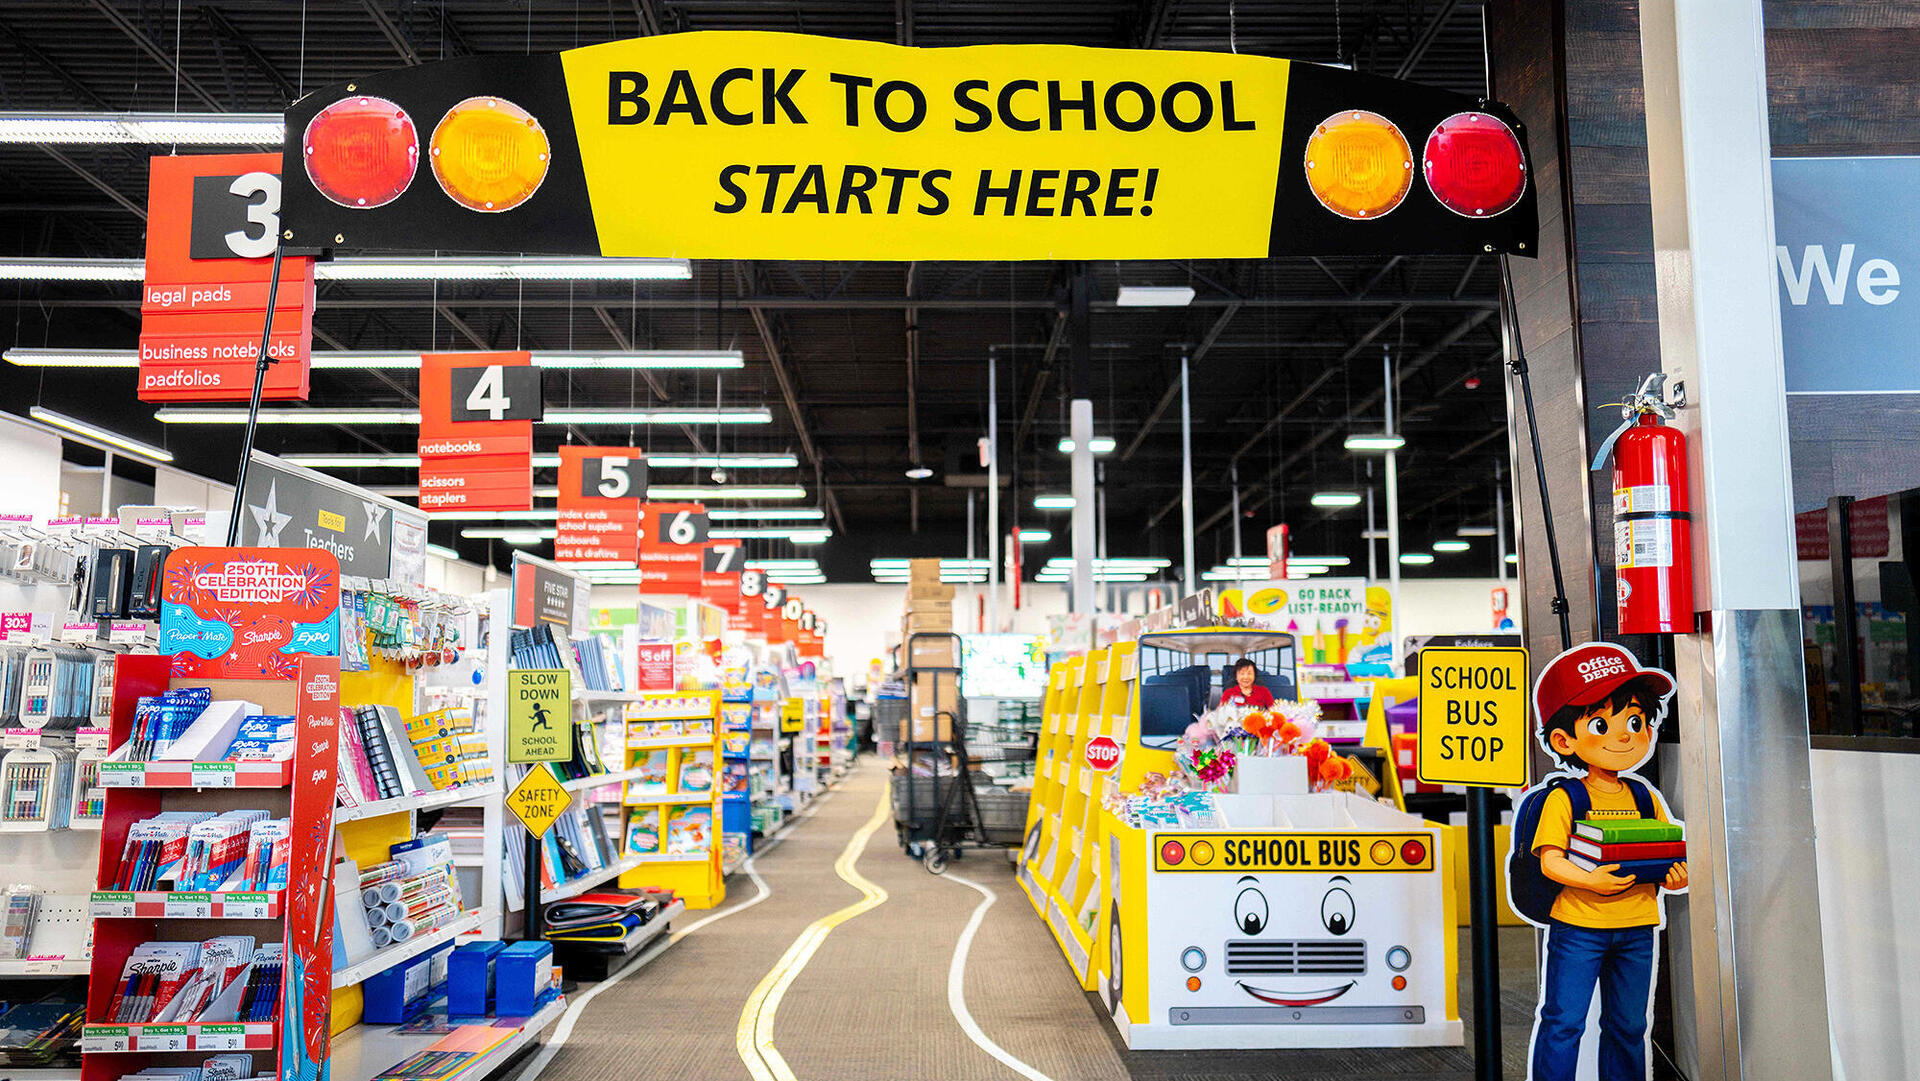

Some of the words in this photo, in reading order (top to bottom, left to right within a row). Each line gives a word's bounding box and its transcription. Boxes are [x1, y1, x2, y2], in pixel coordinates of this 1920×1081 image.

[607, 68, 808, 127] BACK
[830, 73, 928, 132] TO
[954, 79, 1256, 132] SCHOOL
[713, 164, 952, 216] STARTS
[973, 167, 1159, 217] HERE!
[225, 171, 282, 258] 3
[1777, 243, 1900, 306] We
[147, 287, 187, 307] legal
[192, 286, 232, 307] pads
[142, 343, 208, 361] business
[145, 370, 221, 389] padfolios
[466, 365, 511, 421] 4
[420, 440, 482, 455] notebooks
[421, 476, 465, 488] scissors
[598, 456, 630, 498] 5
[421, 491, 467, 506] staplers
[584, 509, 607, 520] cards
[558, 520, 586, 531] school
[588, 522, 623, 533] supplies
[668, 510, 696, 545] 6
[304, 528, 354, 562] Teachers
[556, 535, 600, 546] clipboards
[556, 549, 574, 558] arts
[584, 548, 619, 560] drafting
[713, 545, 737, 574] 7
[227, 565, 275, 576] 250TH
[198, 576, 304, 588] CELEBRATION
[741, 571, 761, 596] 8
[220, 589, 280, 600] EDITION
[763, 586, 782, 609] 9
[1298, 588, 1315, 600] GO
[1319, 588, 1352, 600] BACK
[1288, 602, 1363, 615] LIST-READY!
[166, 628, 198, 641] Paper
[201, 630, 229, 642] Mate
[241, 629, 283, 646] Sharpie
[297, 632, 330, 646] EXPO
[653, 649, 671, 662] off
[1577, 656, 1622, 674] Office
[521, 674, 558, 685] SLOW
[1430, 666, 1517, 691] SCHOOL
[1582, 664, 1626, 683] DEPOT
[520, 689, 559, 700] DOWN
[1446, 700, 1498, 727] BUS
[522, 736, 557, 745] SCHOOL
[525, 747, 555, 756] AHEAD
[1087, 746, 1118, 761] STOP
[1440, 735, 1504, 762] STOP
[518, 789, 560, 802] SAFETY
[524, 804, 554, 818] ZONE
[1225, 839, 1311, 866] SCHOOL
[1319, 840, 1361, 866] BUS
[130, 960, 178, 975] Sharpie
